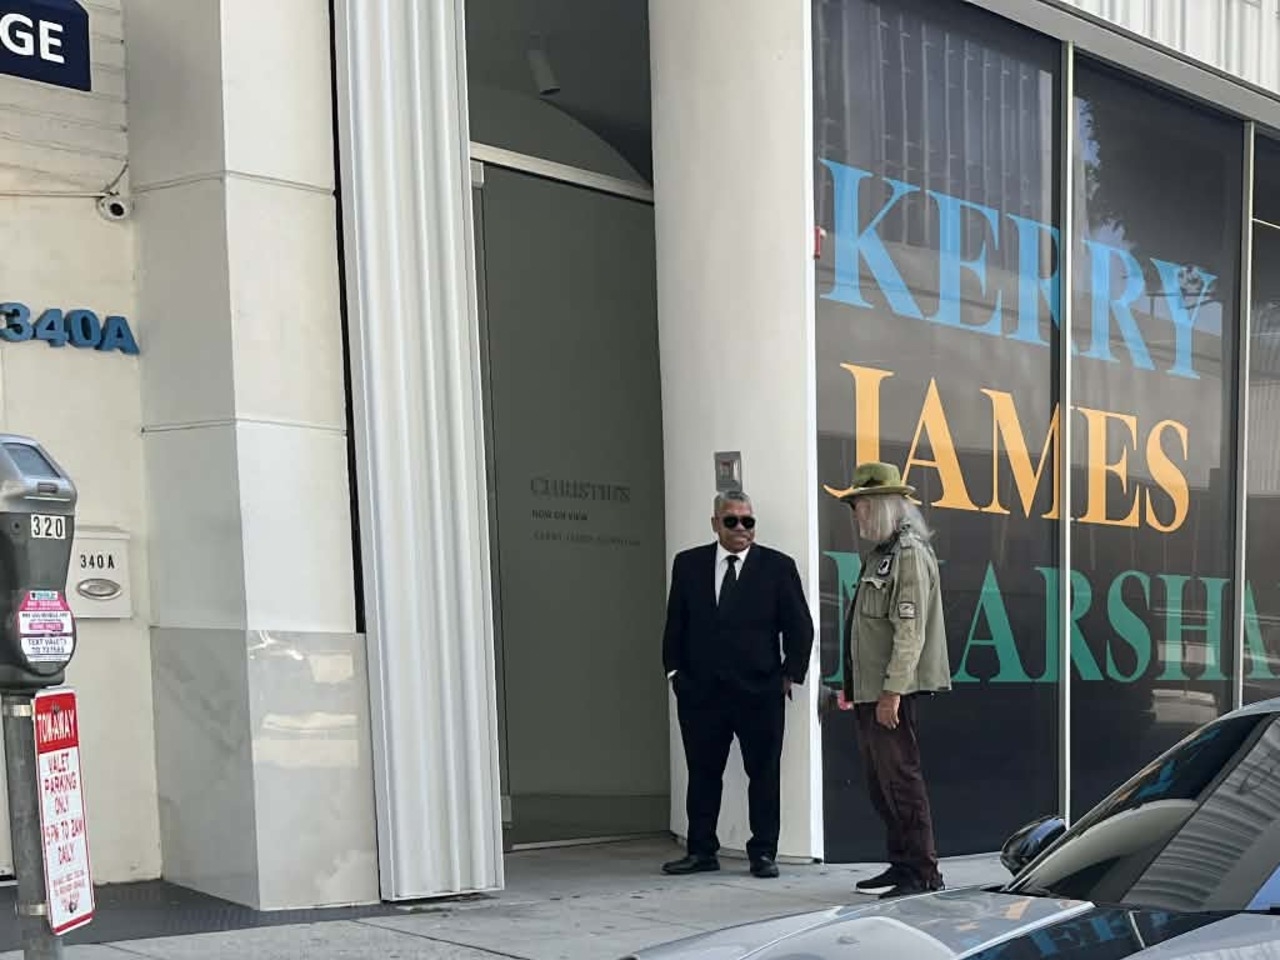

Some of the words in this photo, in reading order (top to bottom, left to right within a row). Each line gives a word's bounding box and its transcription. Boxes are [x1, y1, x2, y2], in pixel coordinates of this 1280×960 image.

[0, 13, 65, 64] GE
[817, 157, 1218, 379] KERRY
[0, 302, 140, 355] 340A
[823, 362, 1190, 532] JAMES
[33, 516, 64, 538] 320
[80, 554, 115, 569] 340A
[48, 752, 69, 774] VALET
[44, 771, 77, 794] PARKING
